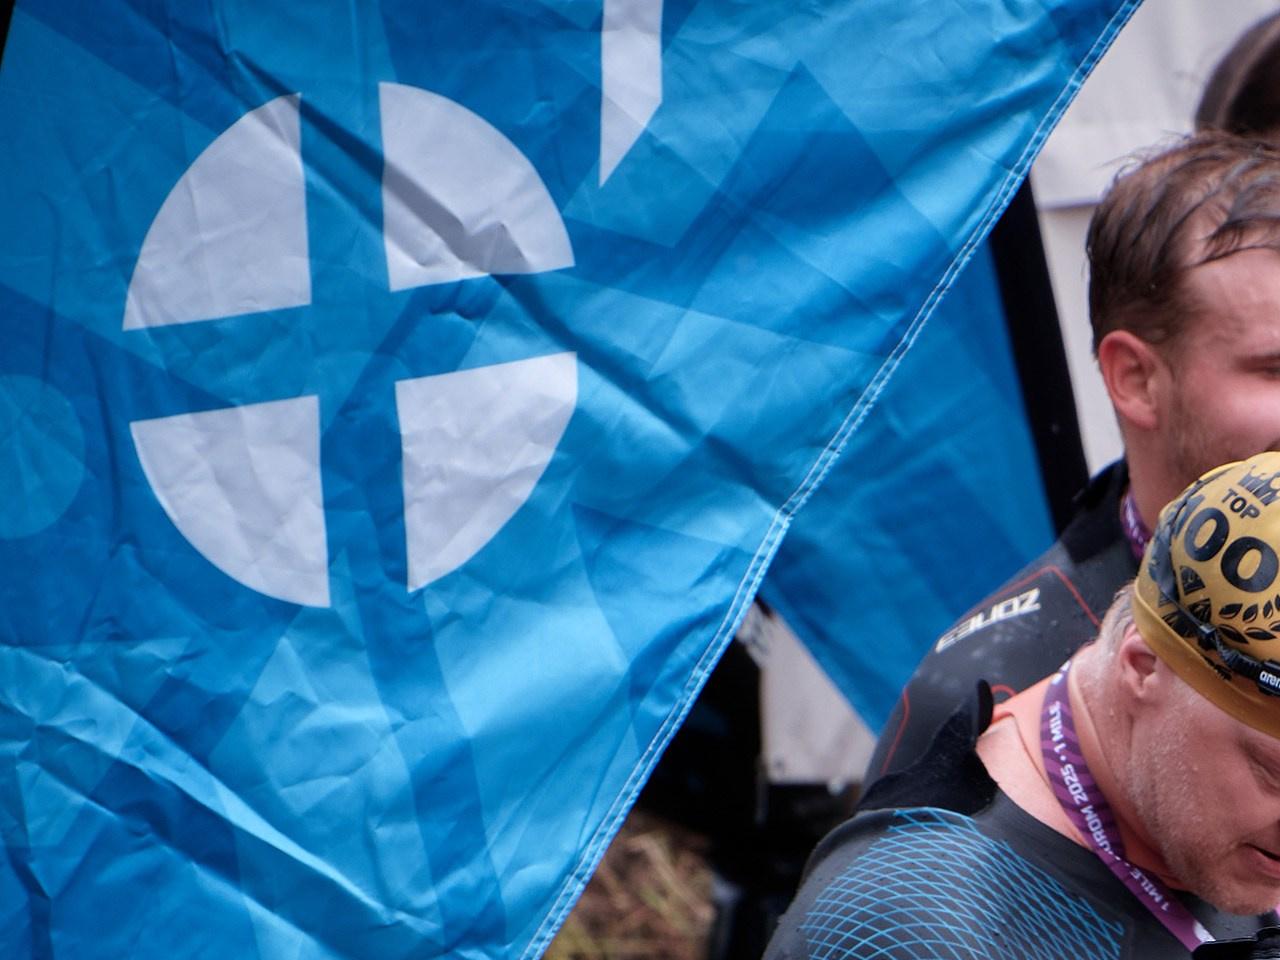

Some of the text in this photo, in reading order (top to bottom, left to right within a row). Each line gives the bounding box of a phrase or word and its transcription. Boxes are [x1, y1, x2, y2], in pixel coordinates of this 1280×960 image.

[1221, 488, 1261, 520] TOP
[1049, 700, 1065, 742] MILE
[1060, 763, 1089, 805] 2025
[1081, 805, 1116, 856] UROM
[1130, 868, 1163, 902] MILE
